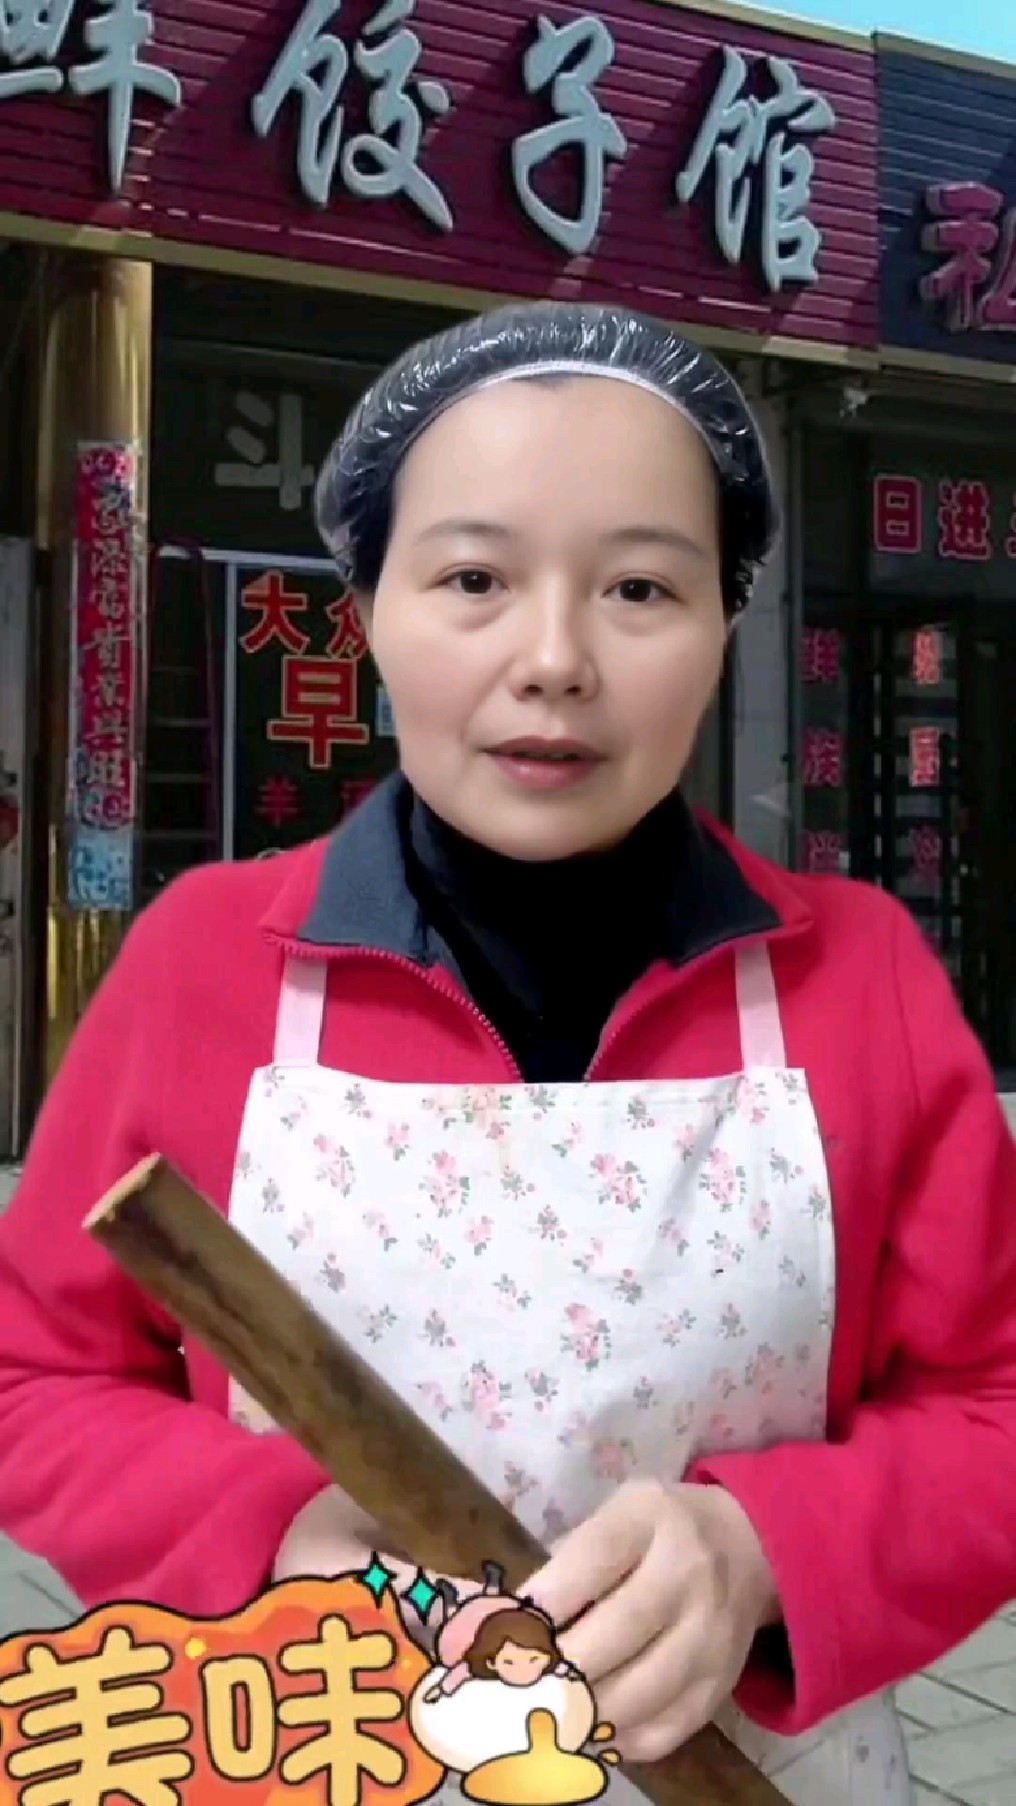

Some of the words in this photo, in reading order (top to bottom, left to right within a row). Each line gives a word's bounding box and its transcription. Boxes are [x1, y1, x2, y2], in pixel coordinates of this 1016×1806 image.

[214, 393, 316, 510] 斗
[872, 475, 1016, 561] 日进
[266, 655, 370, 769] 早
